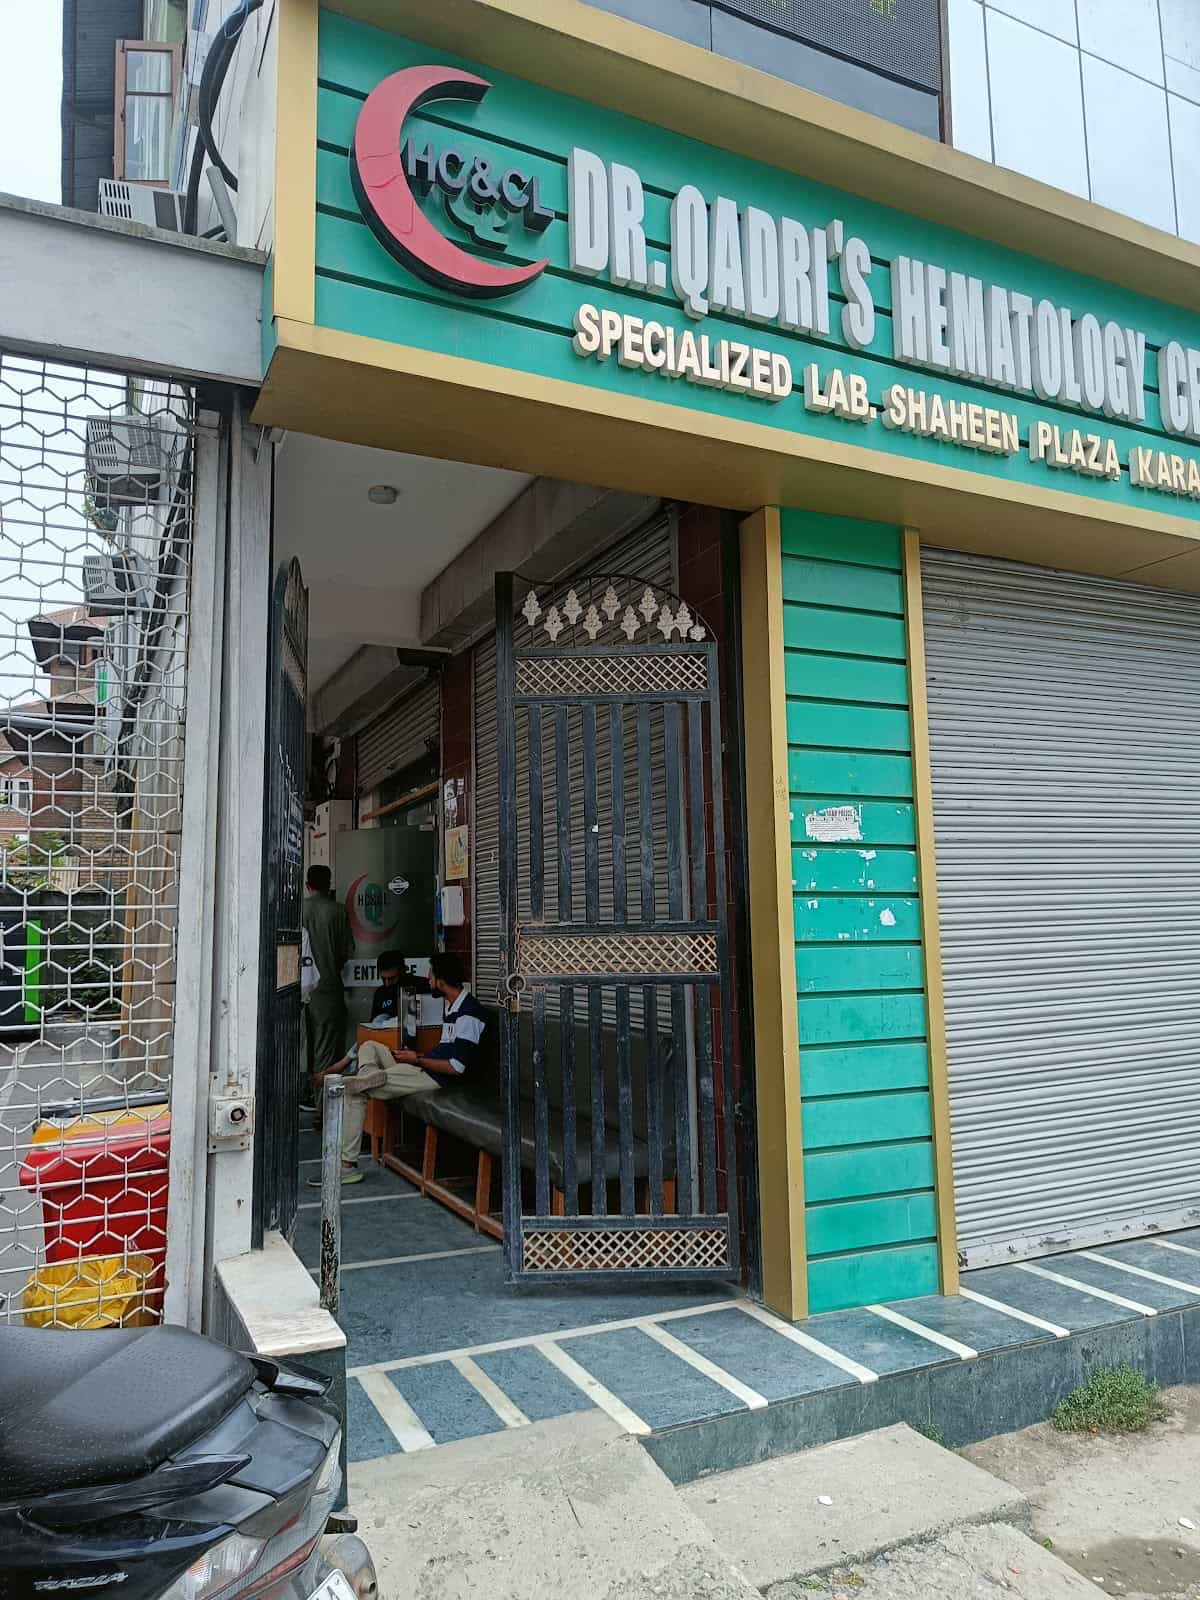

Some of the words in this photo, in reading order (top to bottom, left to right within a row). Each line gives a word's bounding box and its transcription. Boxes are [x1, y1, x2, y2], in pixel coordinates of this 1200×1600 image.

[403, 136, 556, 233] HC&CL
[572, 303, 793, 403] SPECIALIZED
[803, 363, 878, 424] LAB.
[881, 384, 1020, 457] SHAHEEN
[889, 254, 1146, 425] HEMATOLOGY
